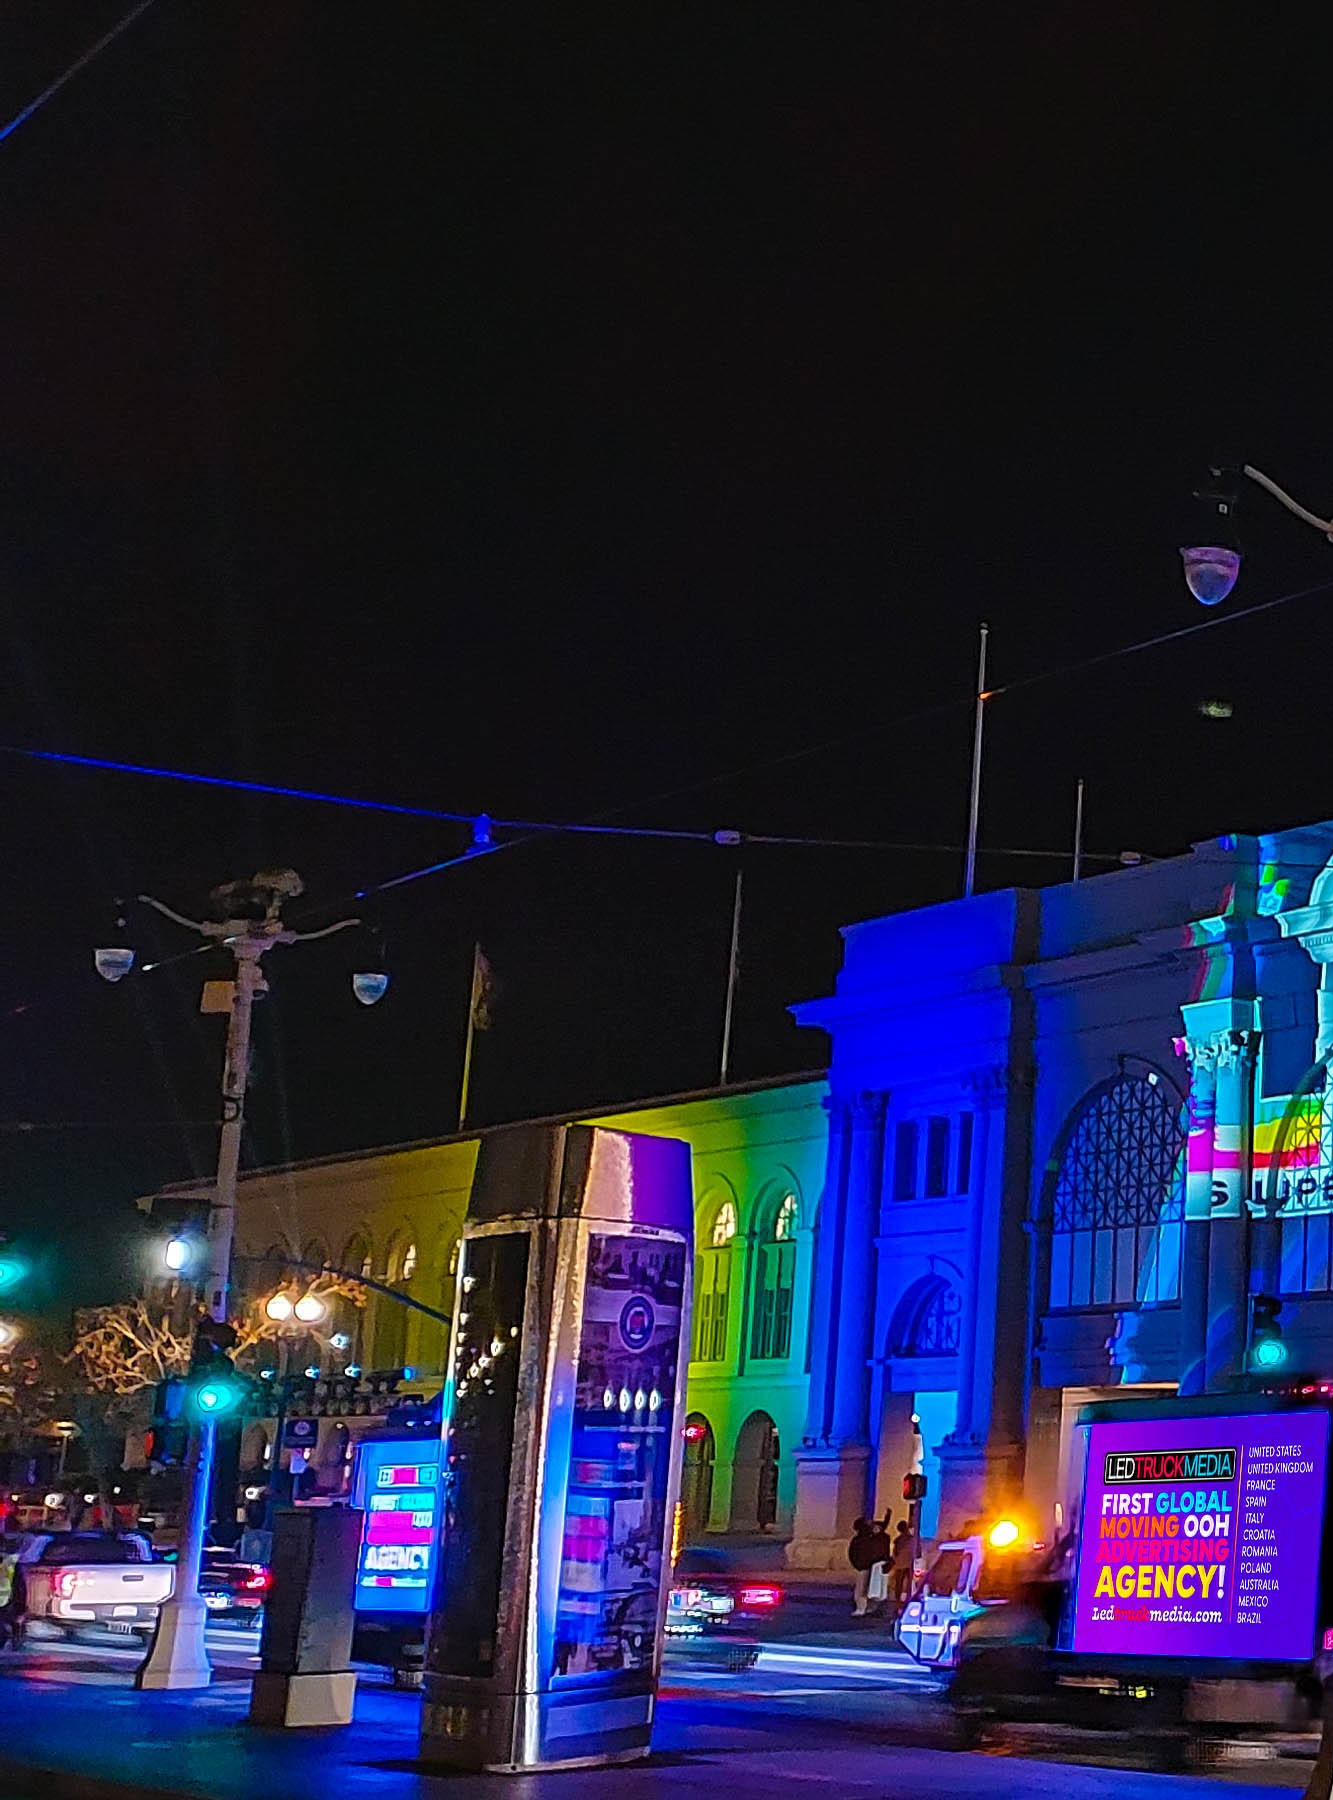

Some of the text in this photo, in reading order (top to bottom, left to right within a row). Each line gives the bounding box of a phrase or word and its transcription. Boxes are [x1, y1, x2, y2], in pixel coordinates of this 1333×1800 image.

[1249, 1445, 1301, 1457] UNITED STATES
[1107, 1453, 1232, 1479] LEDTRUCKMEDIA
[1248, 1461, 1313, 1474] UNITED KINGDOM
[1246, 1479, 1275, 1490] FRANCE
[1102, 1491, 1232, 1514] FIRST GLOBAL
[1246, 1496, 1267, 1507] SPAIN
[1246, 1513, 1264, 1524] ITALY
[1100, 1514, 1229, 1538] MOVING OOH
[1243, 1529, 1275, 1541] CROATIA
[1096, 1539, 1229, 1562] ADVERTISING
[1242, 1546, 1278, 1557] ROMANIA
[1241, 1562, 1271, 1574] POLAND
[1095, 1565, 1226, 1599] AGENCY!
[1240, 1579, 1279, 1591] AUSTRALIA
[1239, 1596, 1268, 1607] MEXICO
[1092, 1606, 1222, 1624] Ledtruckmedia.com
[1237, 1612, 1261, 1624] BRAZIL
